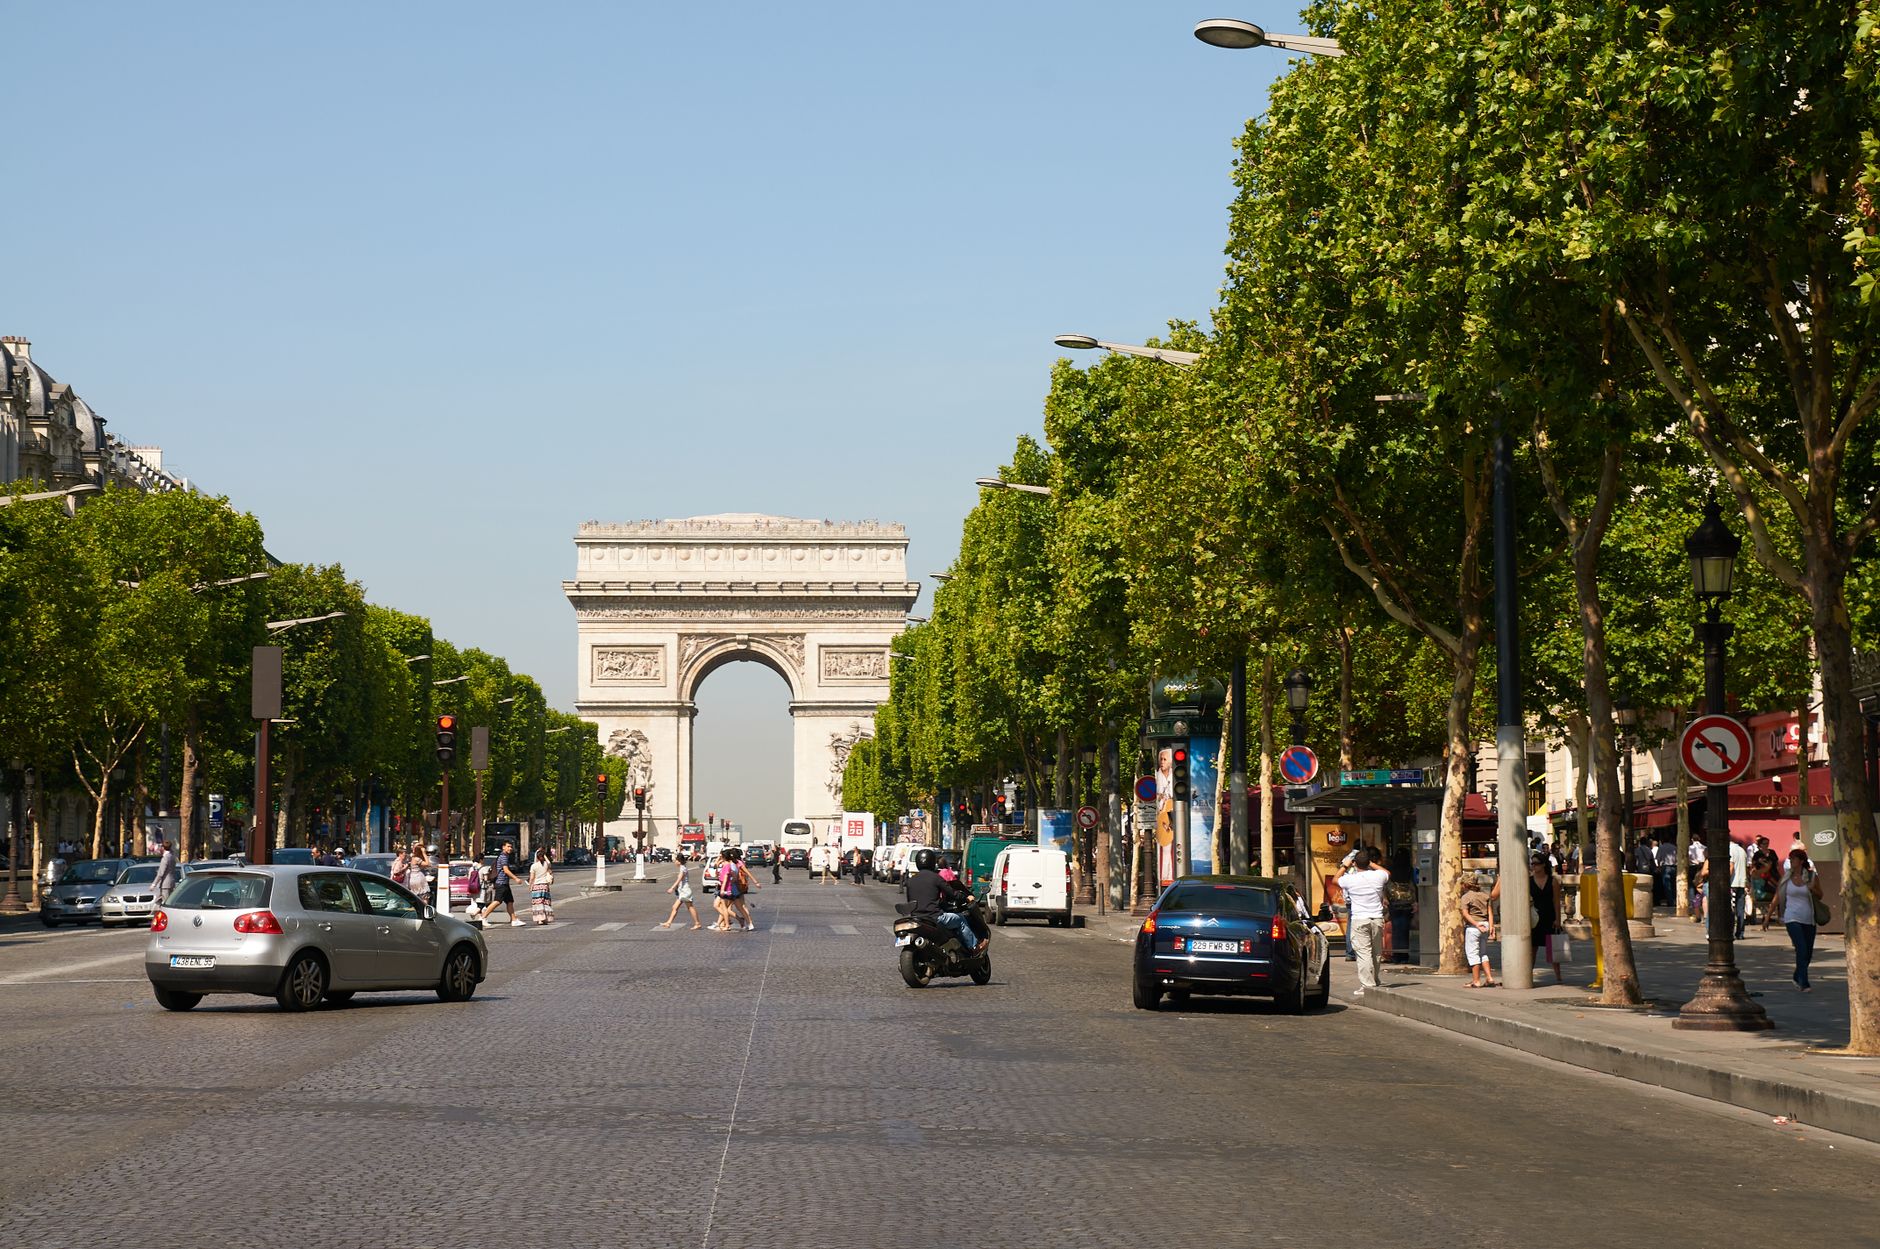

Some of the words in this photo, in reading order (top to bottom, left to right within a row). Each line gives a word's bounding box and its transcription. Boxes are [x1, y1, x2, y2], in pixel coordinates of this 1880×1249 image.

[1758, 794, 1818, 806] GEORE
[209, 802, 221, 818] P
[1328, 832, 1346, 843] legal
[1192, 941, 1207, 950] 229
[1208, 941, 1223, 951] FWR
[1225, 942, 1235, 952] 92
